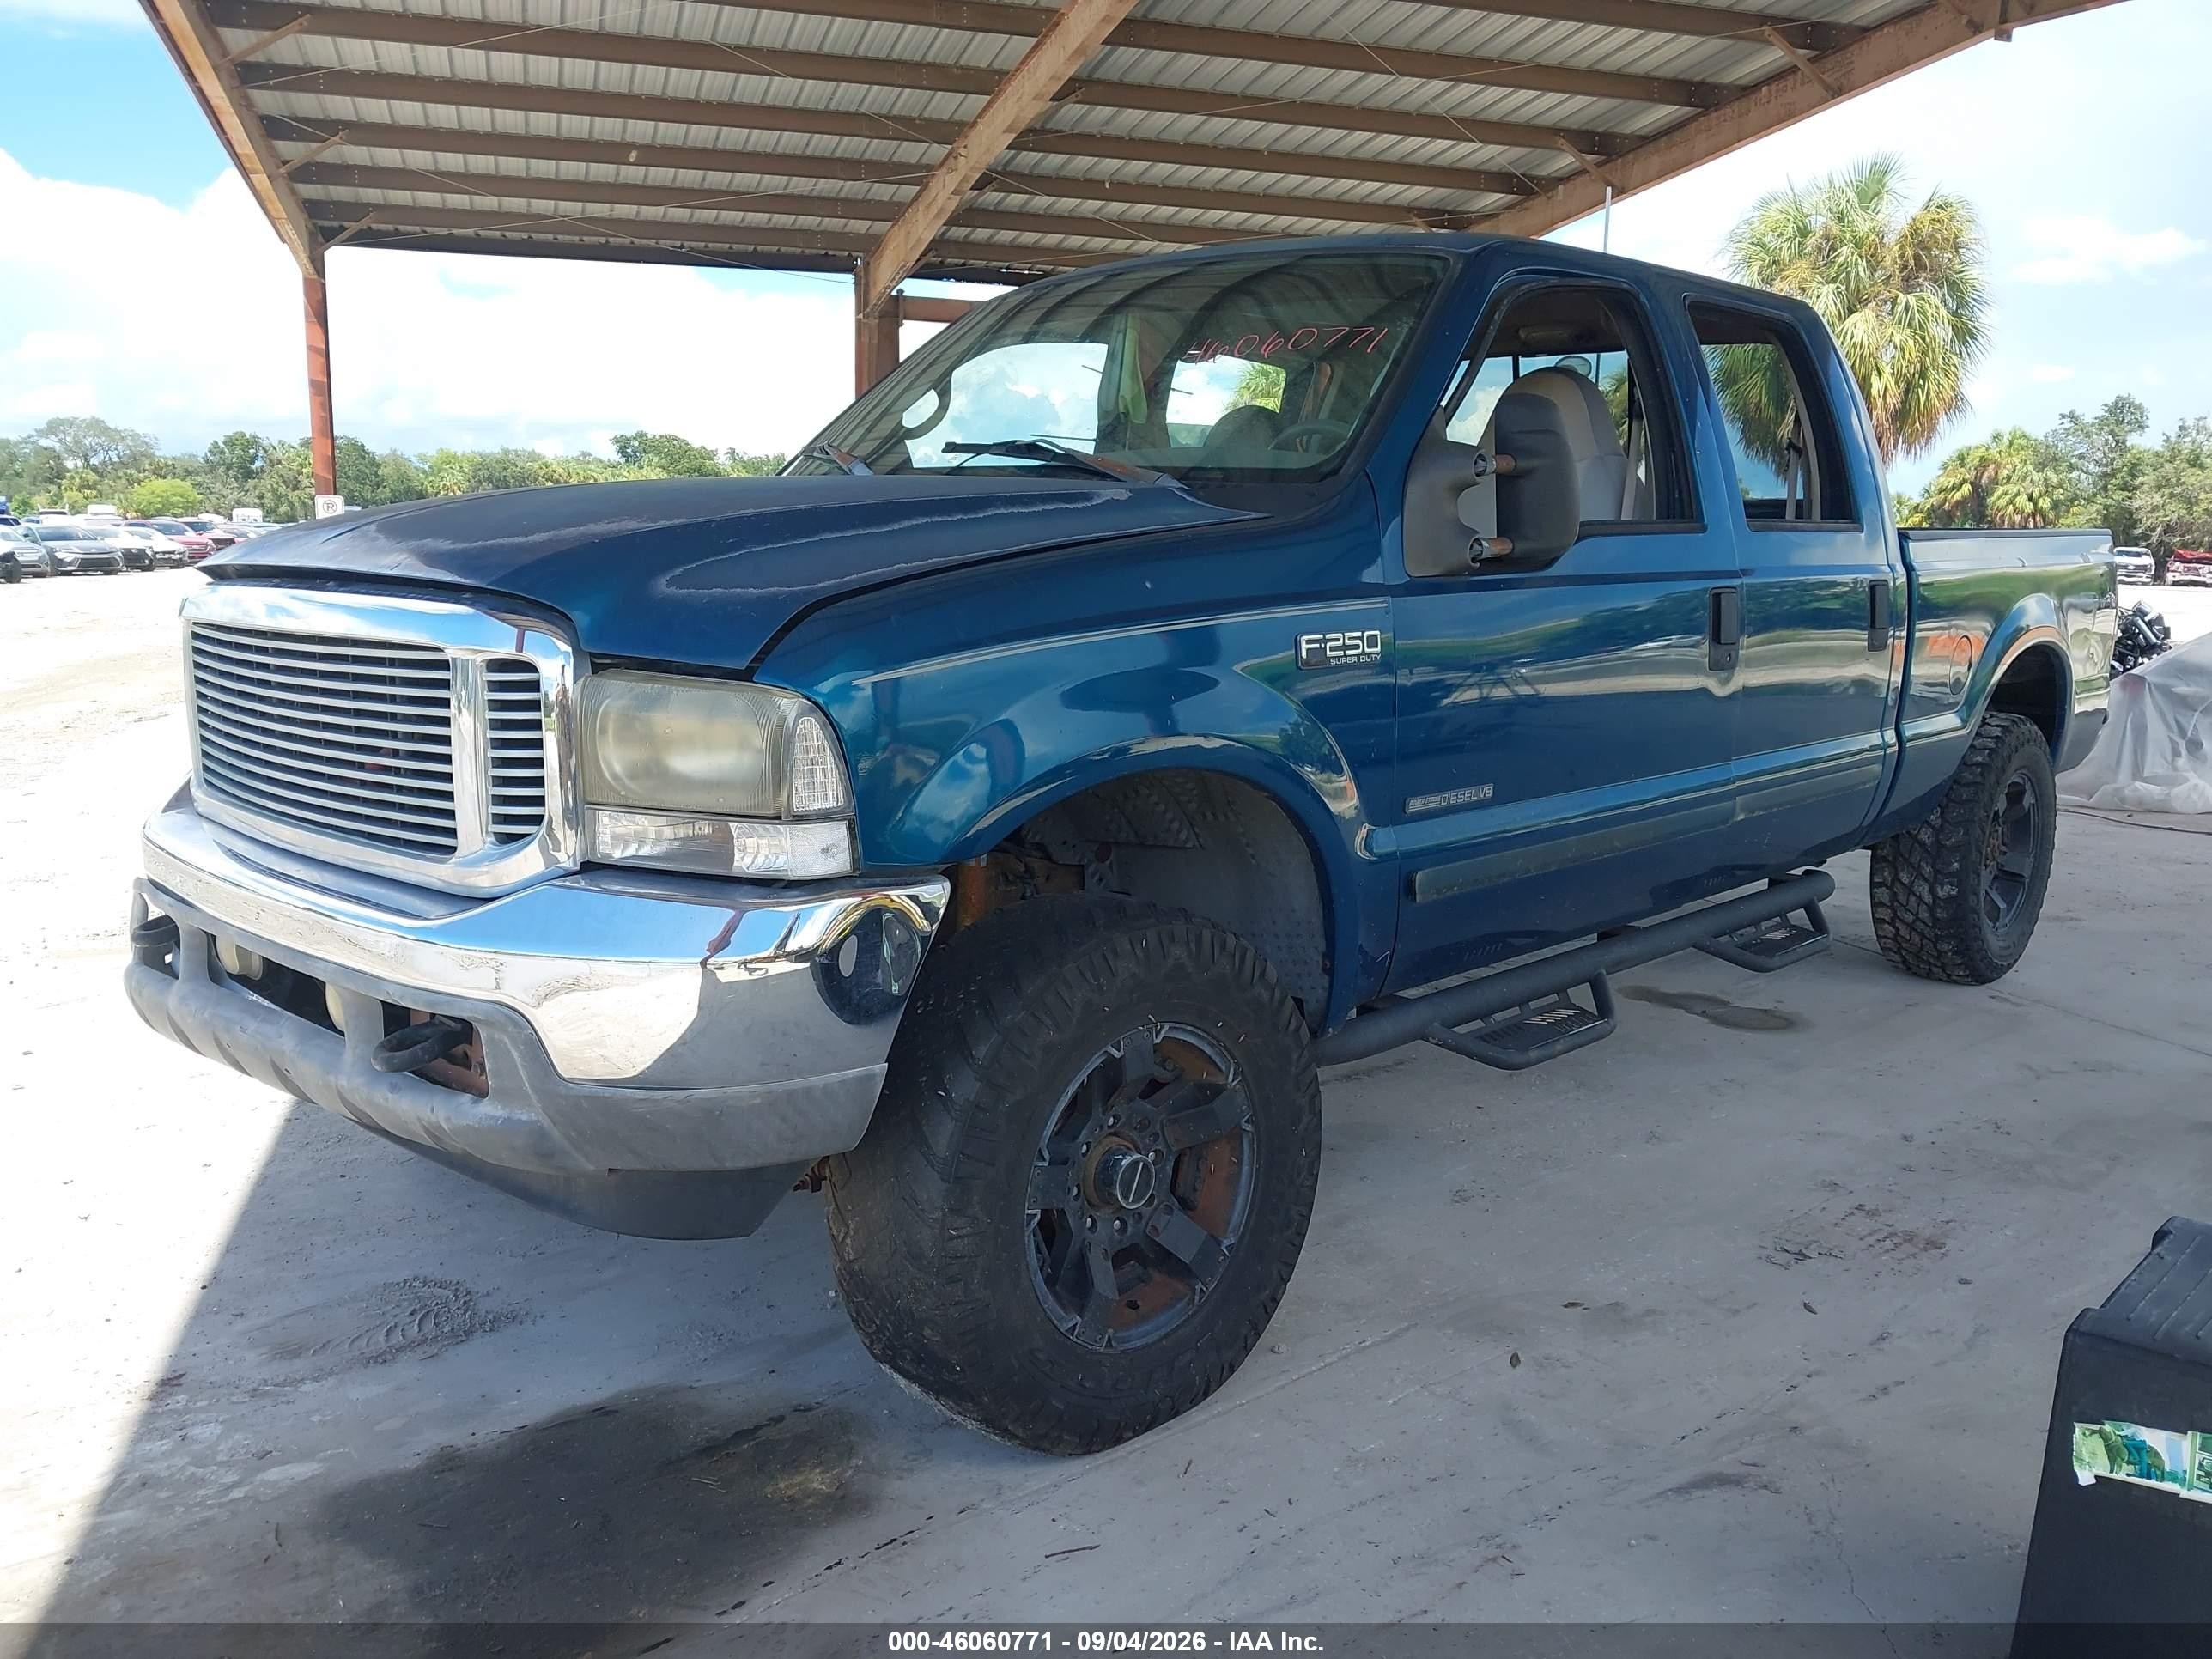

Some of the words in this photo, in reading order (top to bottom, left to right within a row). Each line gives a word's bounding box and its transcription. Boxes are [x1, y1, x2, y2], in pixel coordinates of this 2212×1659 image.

[1329, 656, 1358, 665] SUPER
[1359, 653, 1382, 663] DUTY
[1440, 789, 1478, 806] DIESEL
[1479, 786, 1494, 799] V8
